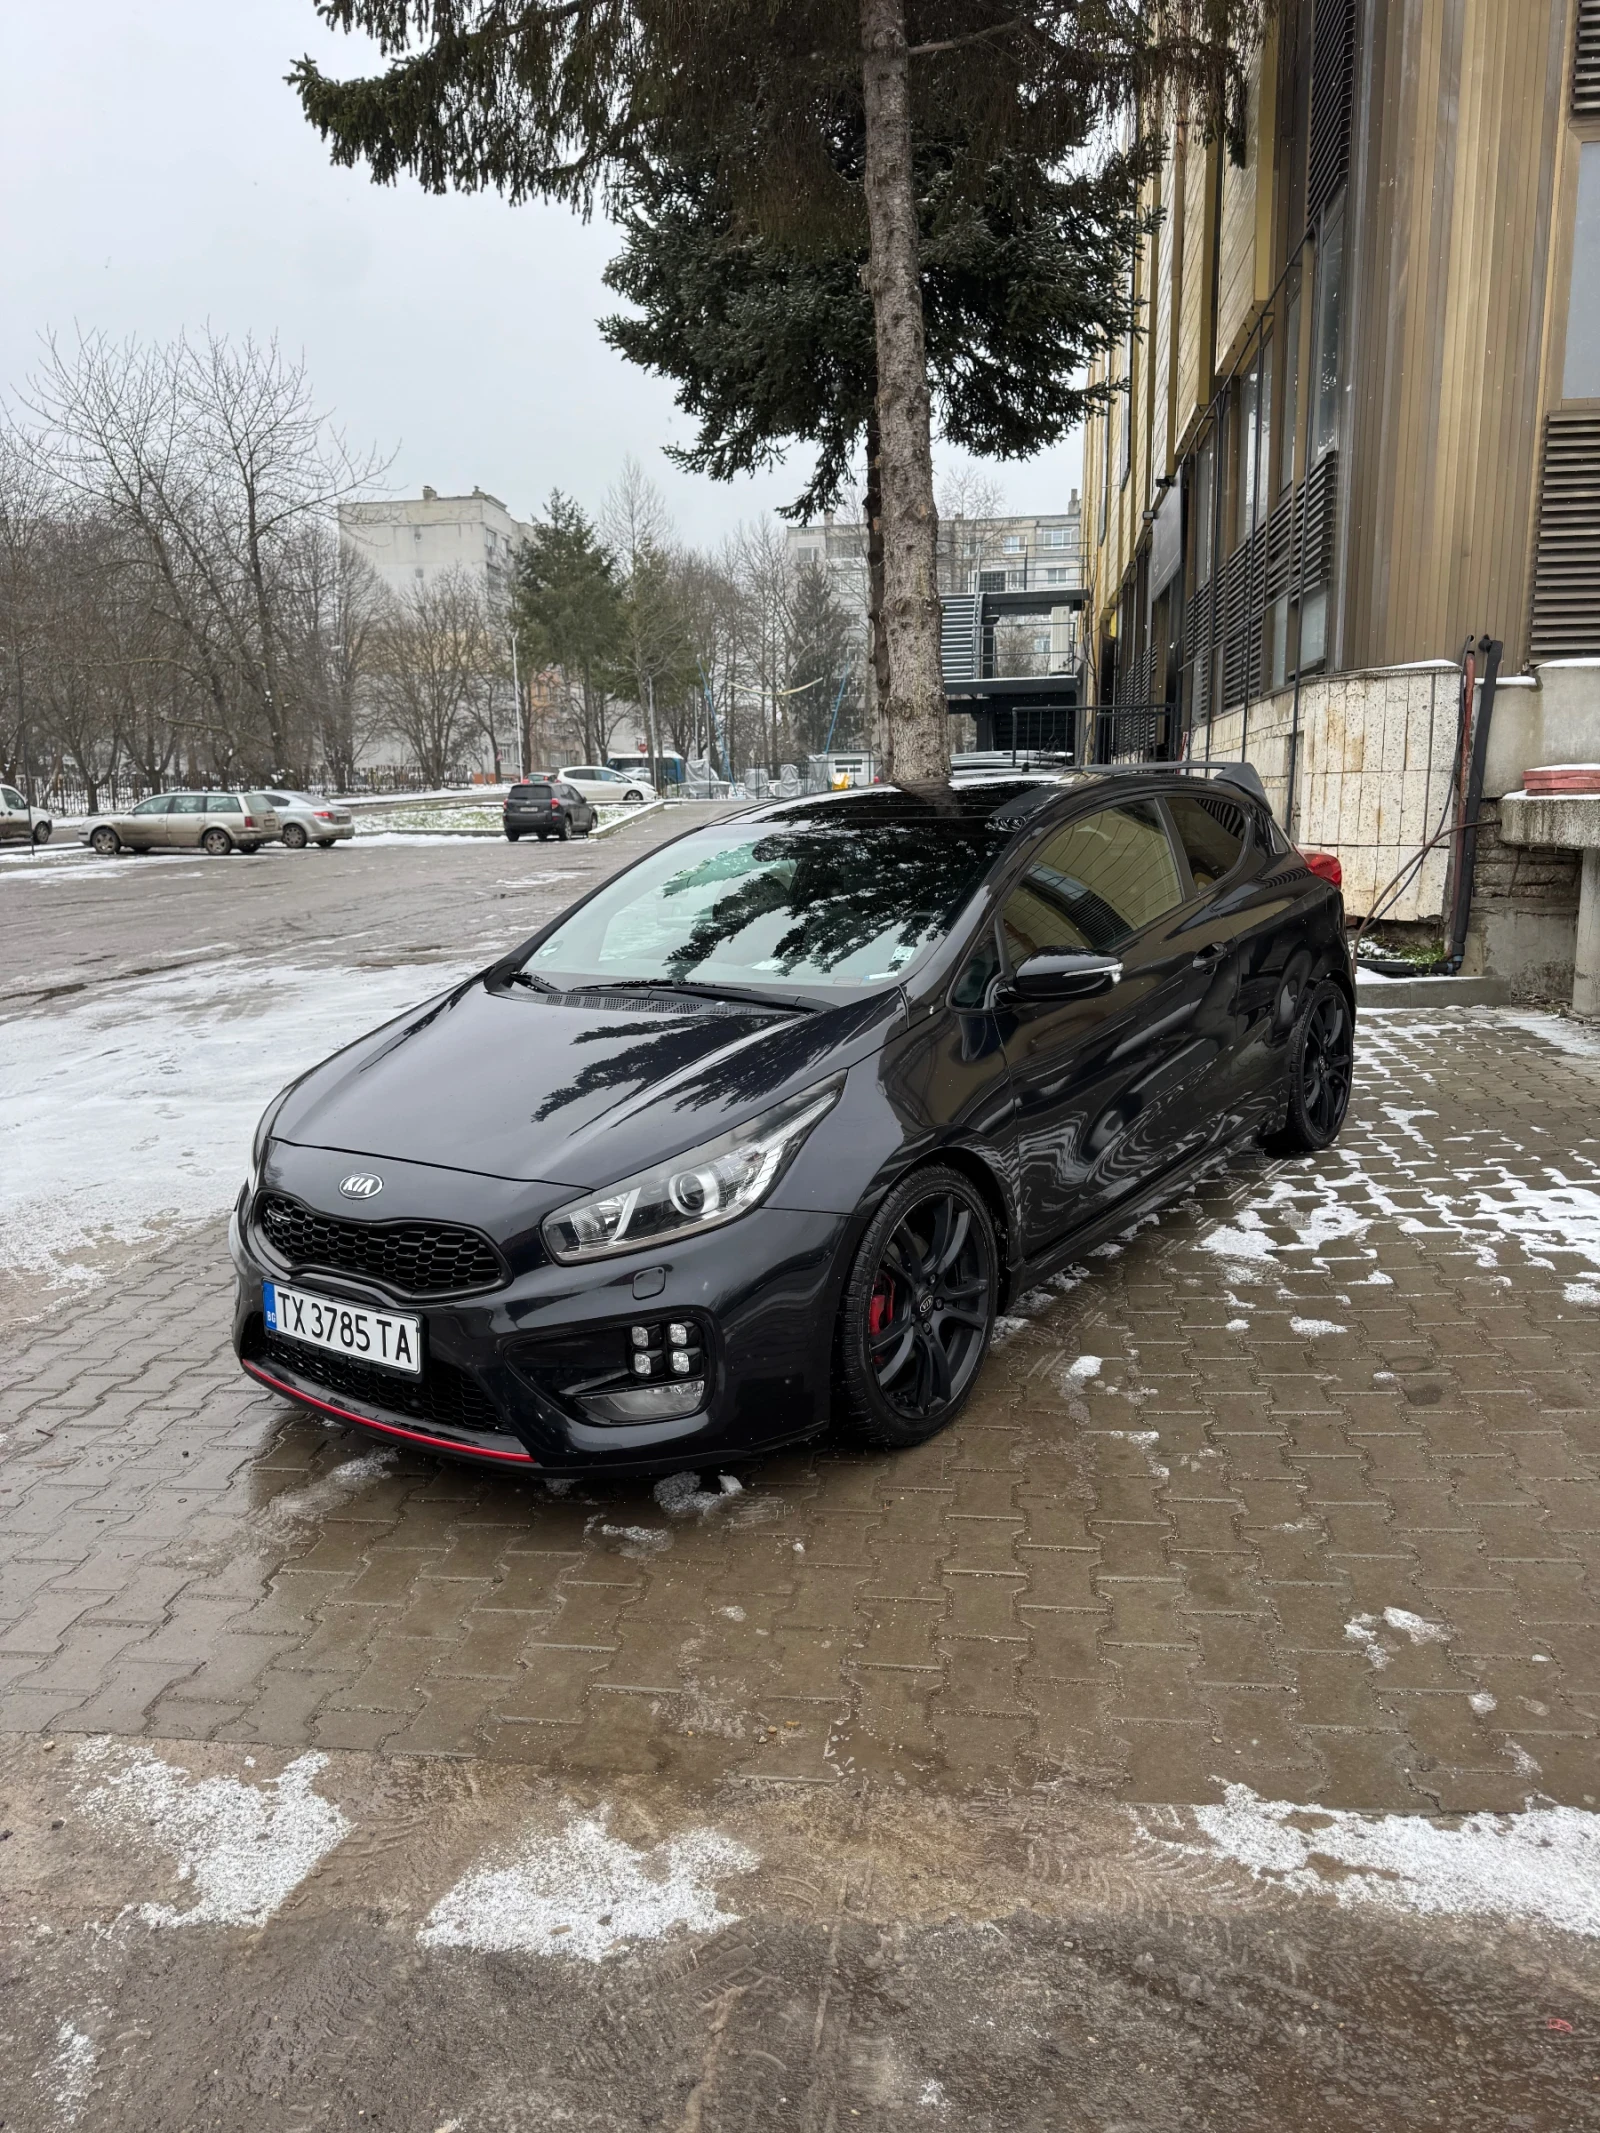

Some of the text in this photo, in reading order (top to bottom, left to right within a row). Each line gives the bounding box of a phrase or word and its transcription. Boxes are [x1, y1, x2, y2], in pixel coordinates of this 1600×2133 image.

[343, 1177, 374, 1195] KIA
[267, 1311, 276, 1323] BG
[278, 1292, 412, 1363] TX 3785 TA
